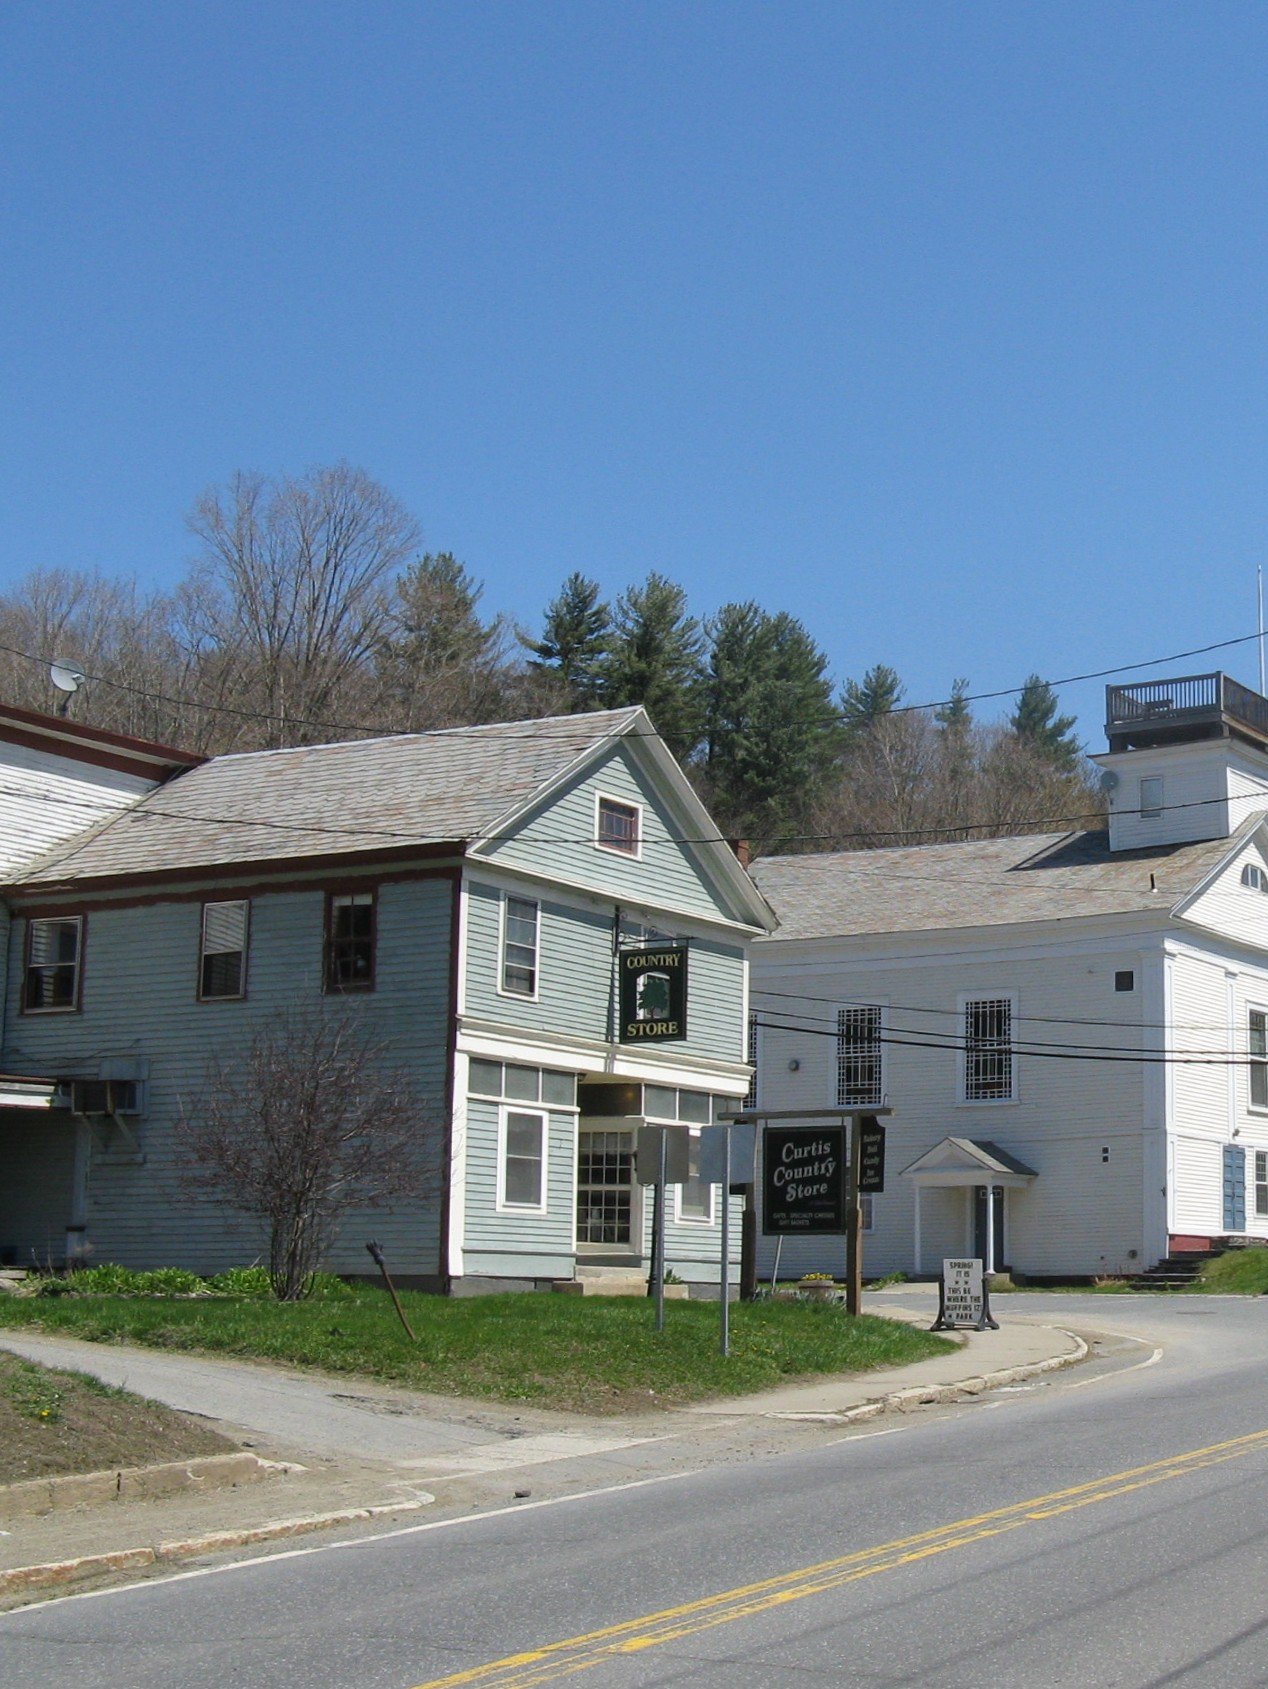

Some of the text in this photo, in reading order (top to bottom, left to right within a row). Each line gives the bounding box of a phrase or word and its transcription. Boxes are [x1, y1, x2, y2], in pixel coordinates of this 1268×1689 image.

[627, 953, 681, 969] COUNTRY
[627, 1021, 679, 1037] STORE
[782, 1141, 831, 1163] Curtis
[773, 1158, 836, 1187] Country
[786, 1183, 828, 1202] Store
[970, 1295, 981, 1303] THE
